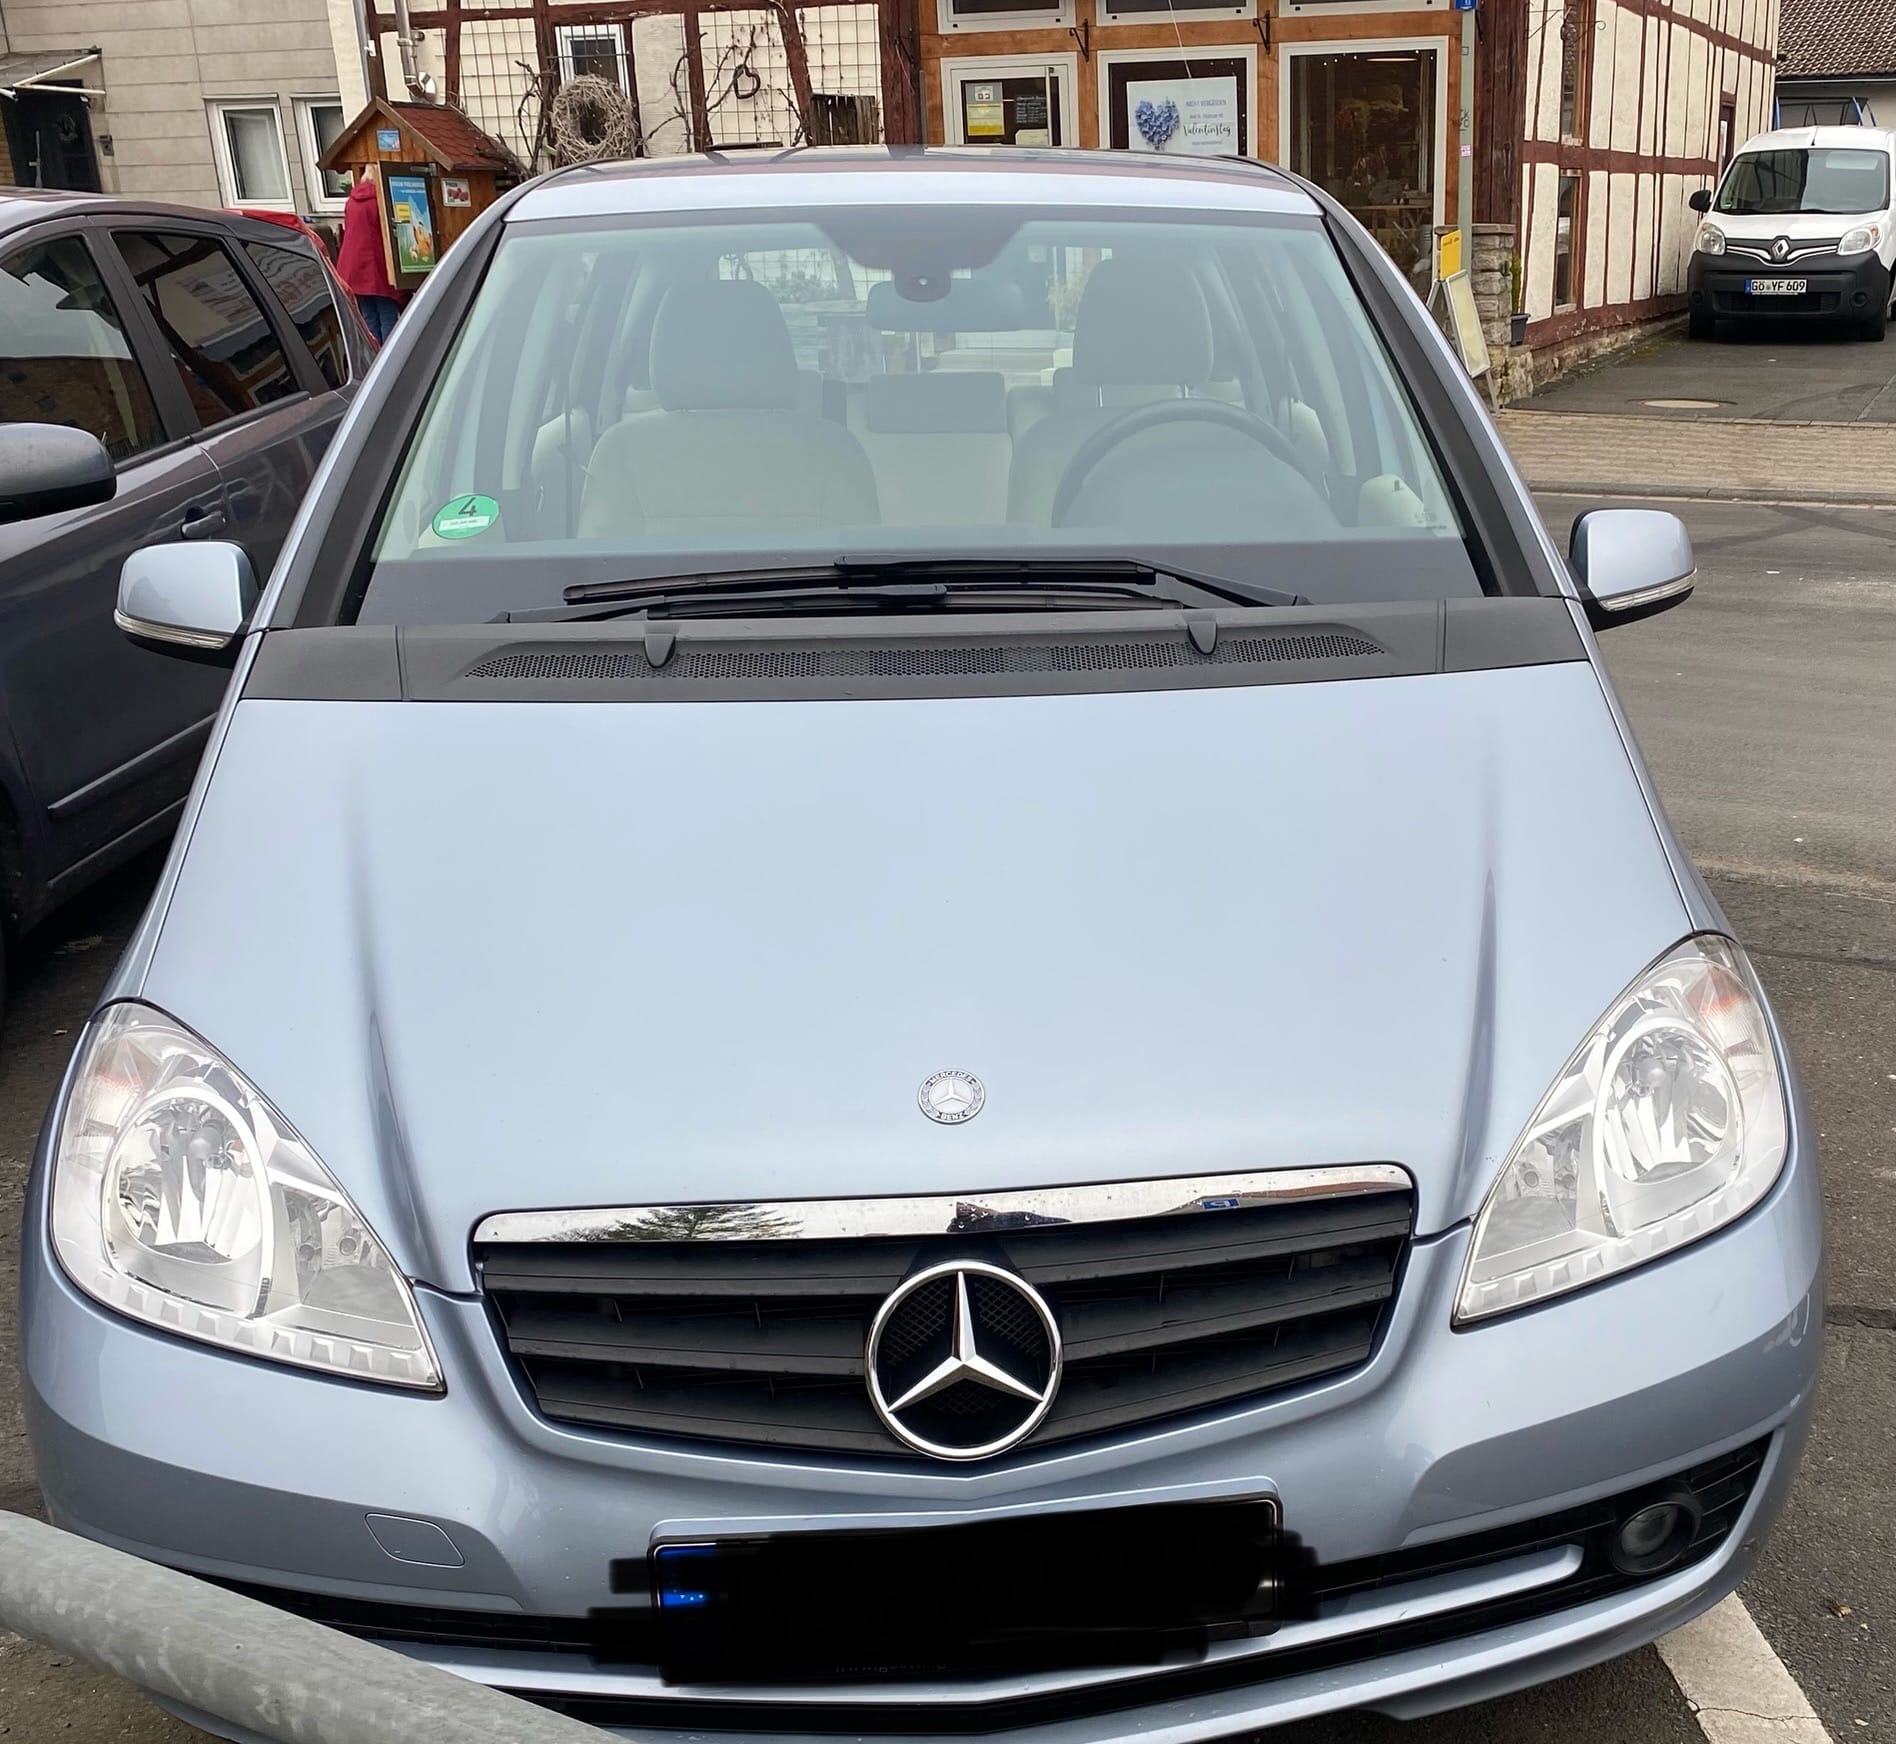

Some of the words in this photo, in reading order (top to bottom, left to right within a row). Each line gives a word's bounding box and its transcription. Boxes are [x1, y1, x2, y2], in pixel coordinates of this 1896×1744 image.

[1751, 280, 1765, 291] GÖ
[1771, 280, 1785, 291] YF
[1786, 280, 1806, 291] 609
[458, 497, 477, 516] 4
[927, 1071, 973, 1086] MERCEDES
[940, 1111, 964, 1121] BENZ
